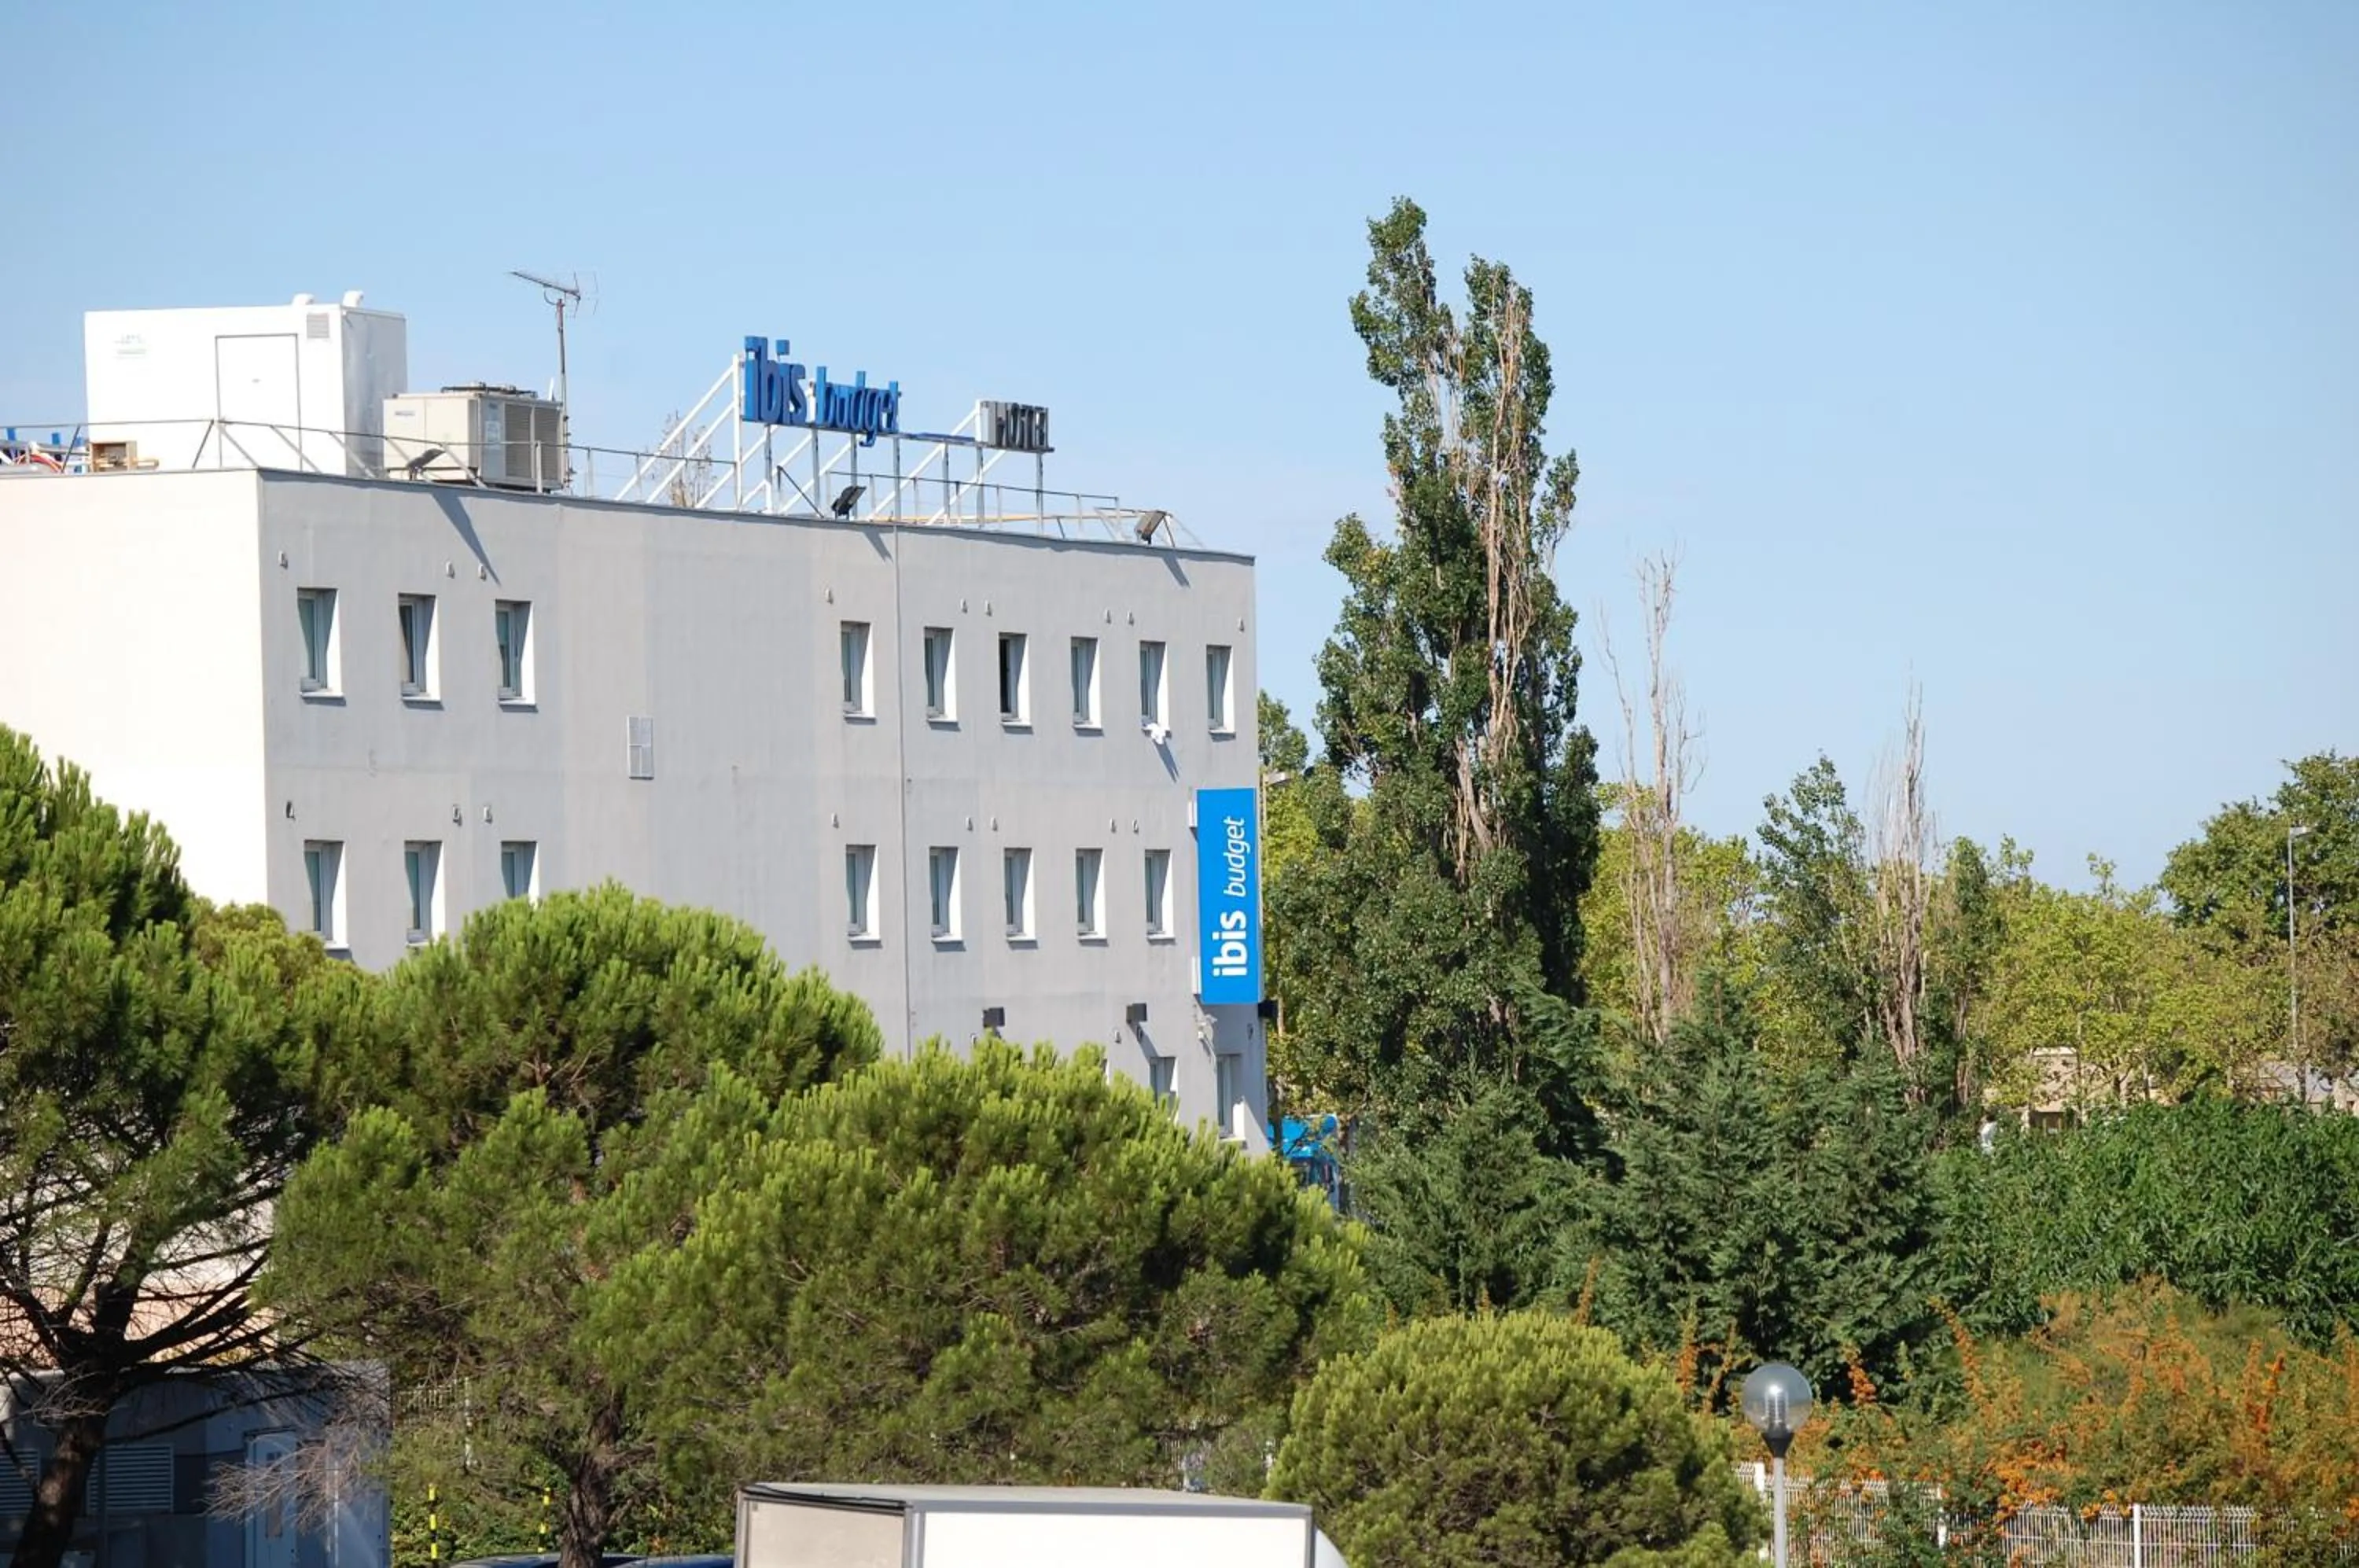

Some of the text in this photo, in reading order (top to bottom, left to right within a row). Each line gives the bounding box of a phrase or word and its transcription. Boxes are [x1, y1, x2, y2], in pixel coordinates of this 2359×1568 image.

[745, 336, 899, 447] ibis budget
[1212, 815, 1251, 977] ibis budget
